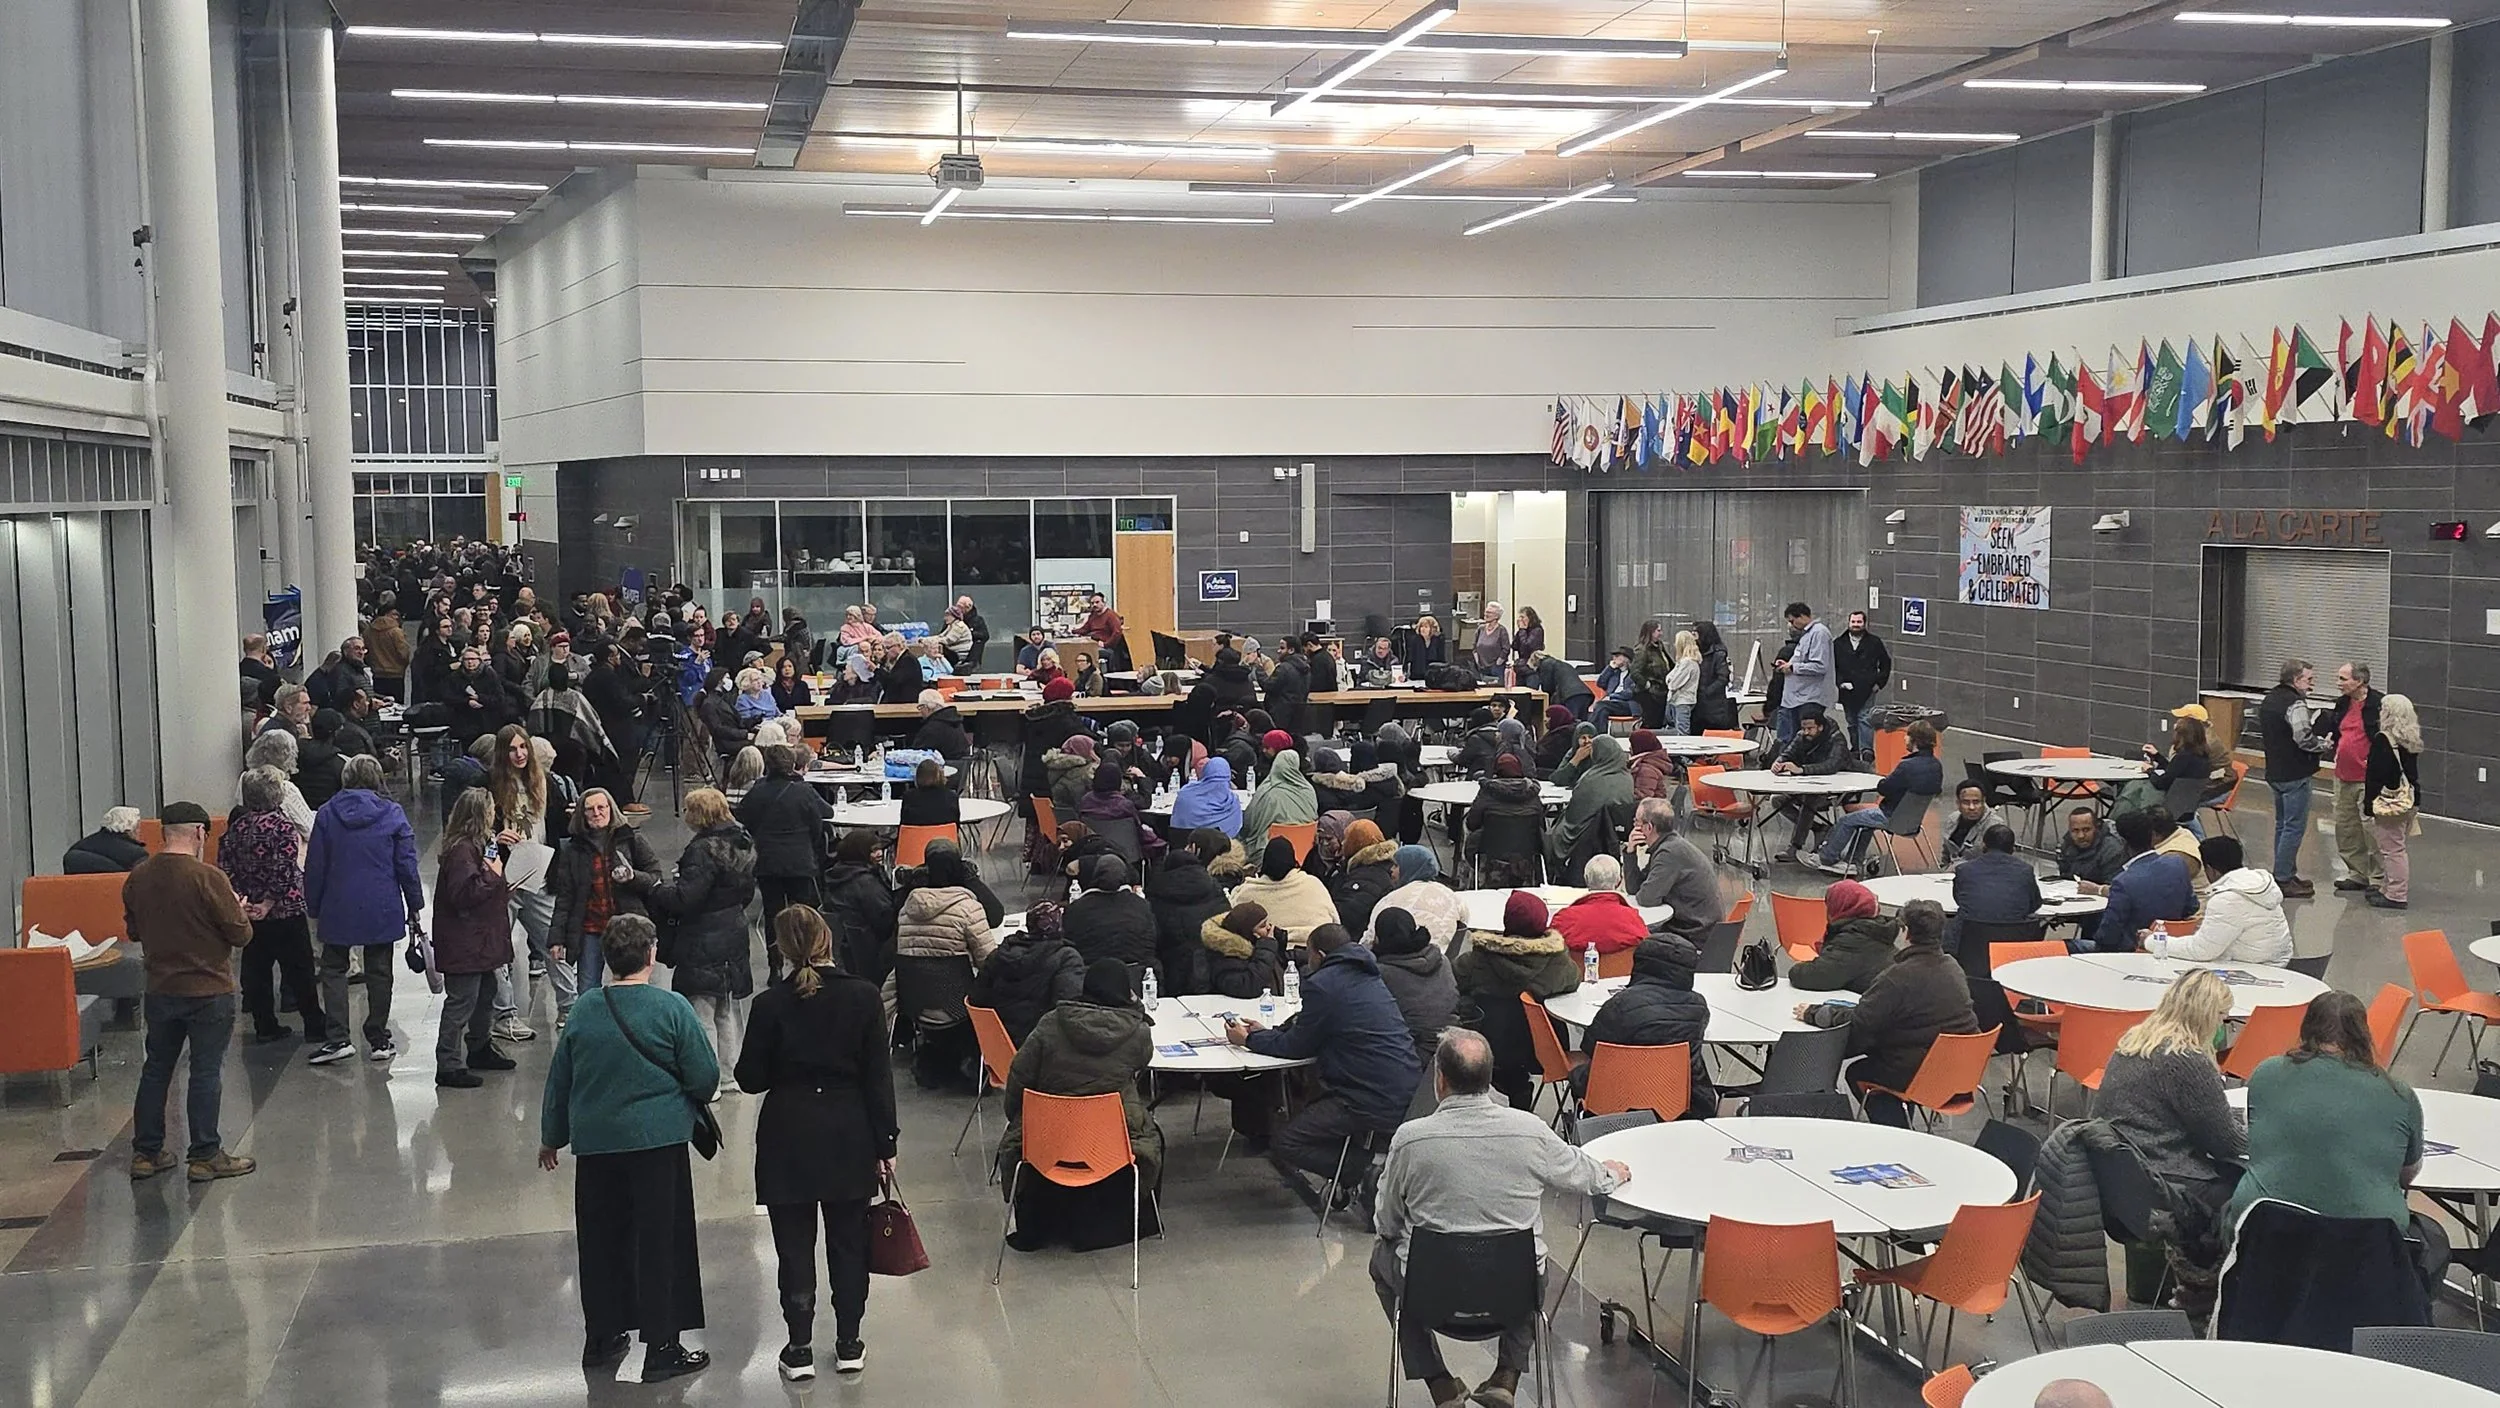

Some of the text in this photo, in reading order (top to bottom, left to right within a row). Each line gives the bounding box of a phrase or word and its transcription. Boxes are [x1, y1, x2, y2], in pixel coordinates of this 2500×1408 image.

[2207, 510, 2384, 544] A LA CARTE
[1977, 553, 2031, 577] EMBRACED
[1968, 578, 2040, 605] & CELEBRATED
